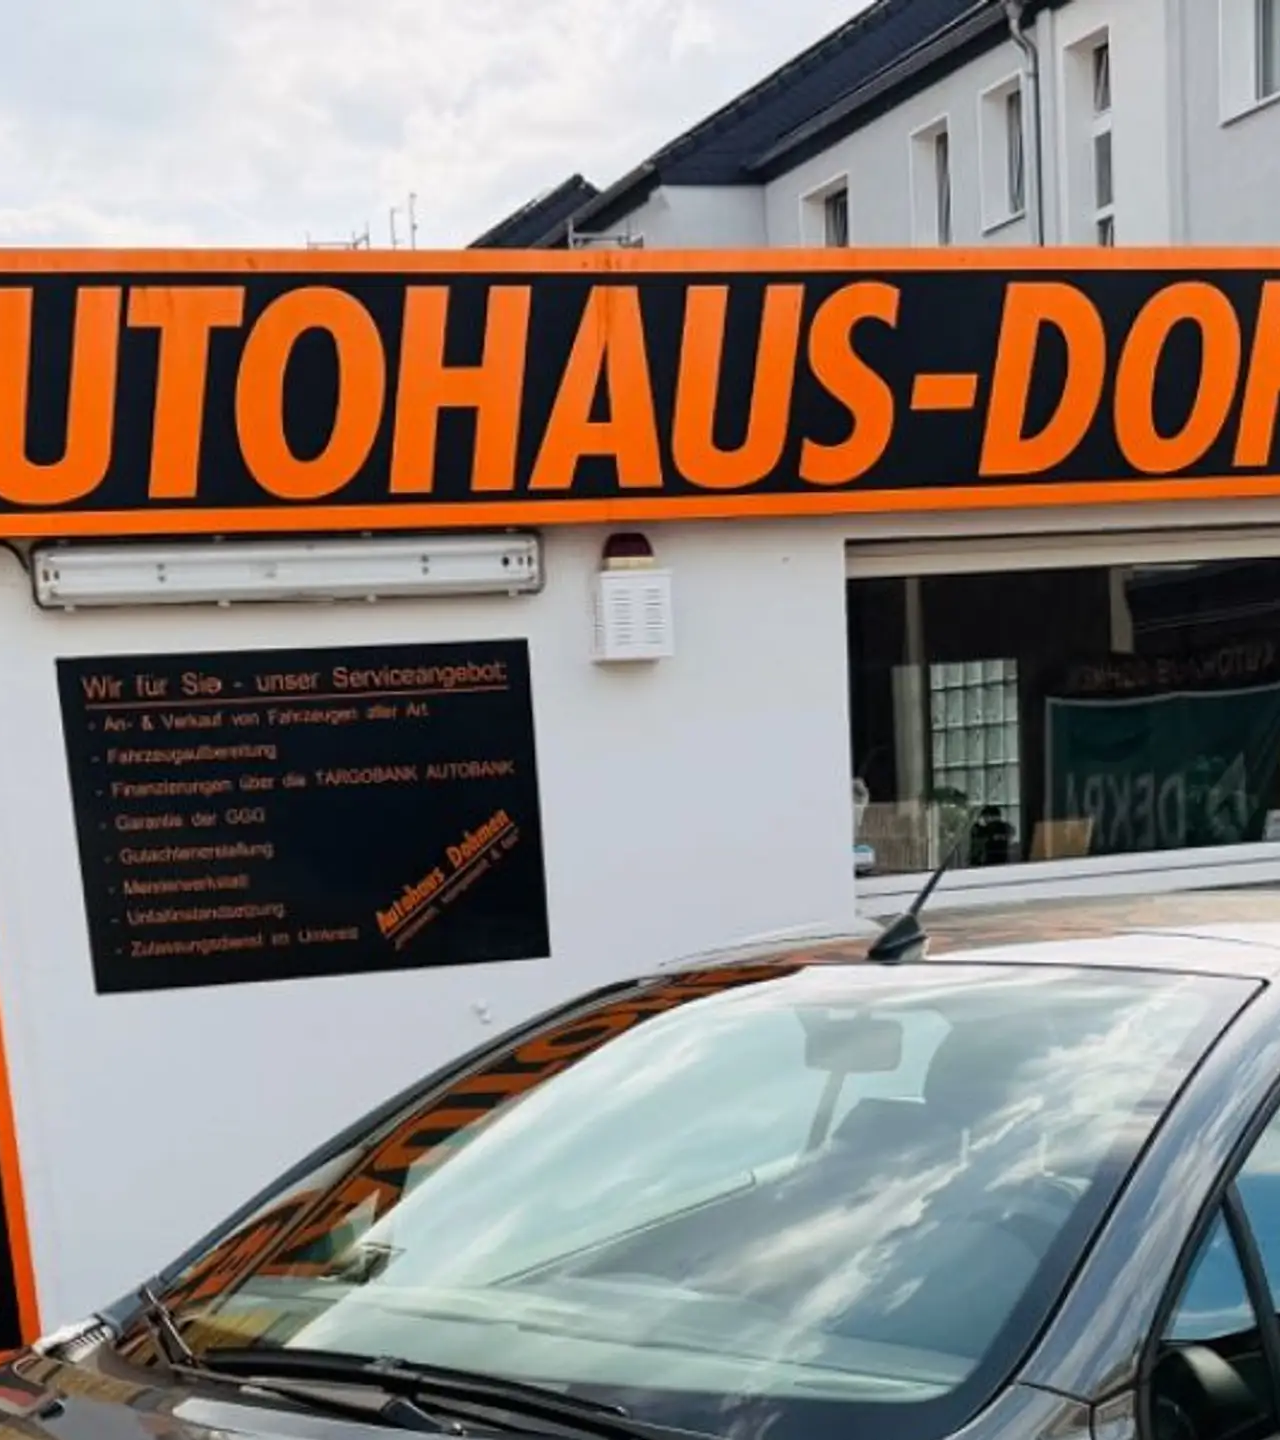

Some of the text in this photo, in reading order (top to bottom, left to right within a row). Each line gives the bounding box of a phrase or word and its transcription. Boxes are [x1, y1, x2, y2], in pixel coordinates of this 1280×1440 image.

[82, 674, 122, 699] Wir
[134, 672, 168, 697] für
[181, 671, 222, 695] Sie
[254, 670, 319, 693] unser
